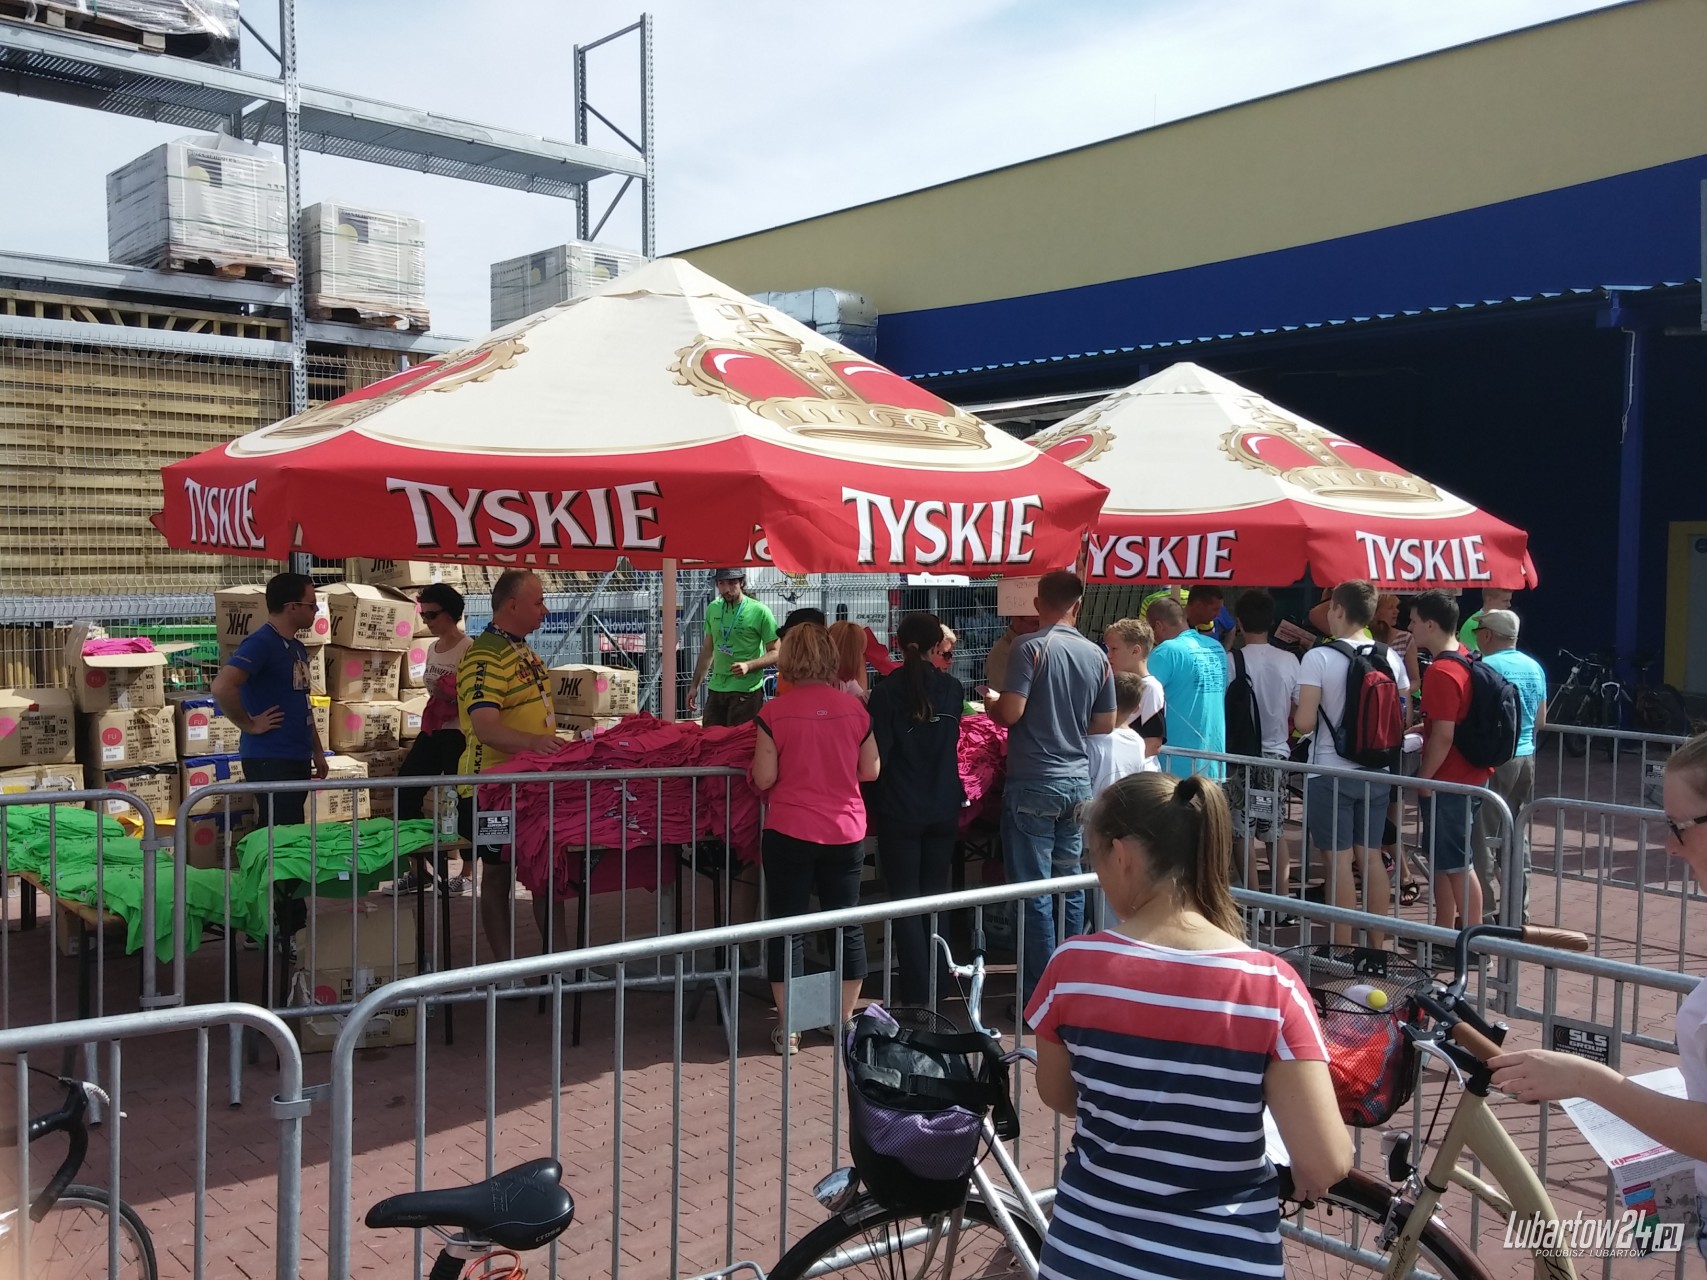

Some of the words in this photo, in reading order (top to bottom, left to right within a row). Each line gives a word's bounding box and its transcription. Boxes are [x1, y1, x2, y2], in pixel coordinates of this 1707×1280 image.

[183, 476, 266, 549] TYSKIE
[385, 476, 665, 551] TYSKIE
[841, 486, 1044, 566] TYSKIE
[1087, 529, 1239, 580] YSKIE
[1355, 530, 1492, 582] TYSKIE
[226, 613, 252, 635] JHK
[558, 678, 583, 696] JHK
[394, 1008, 406, 1017] US
[1568, 1040, 1607, 1052] GROUP
[1569, 1028, 1607, 1047] SLS
